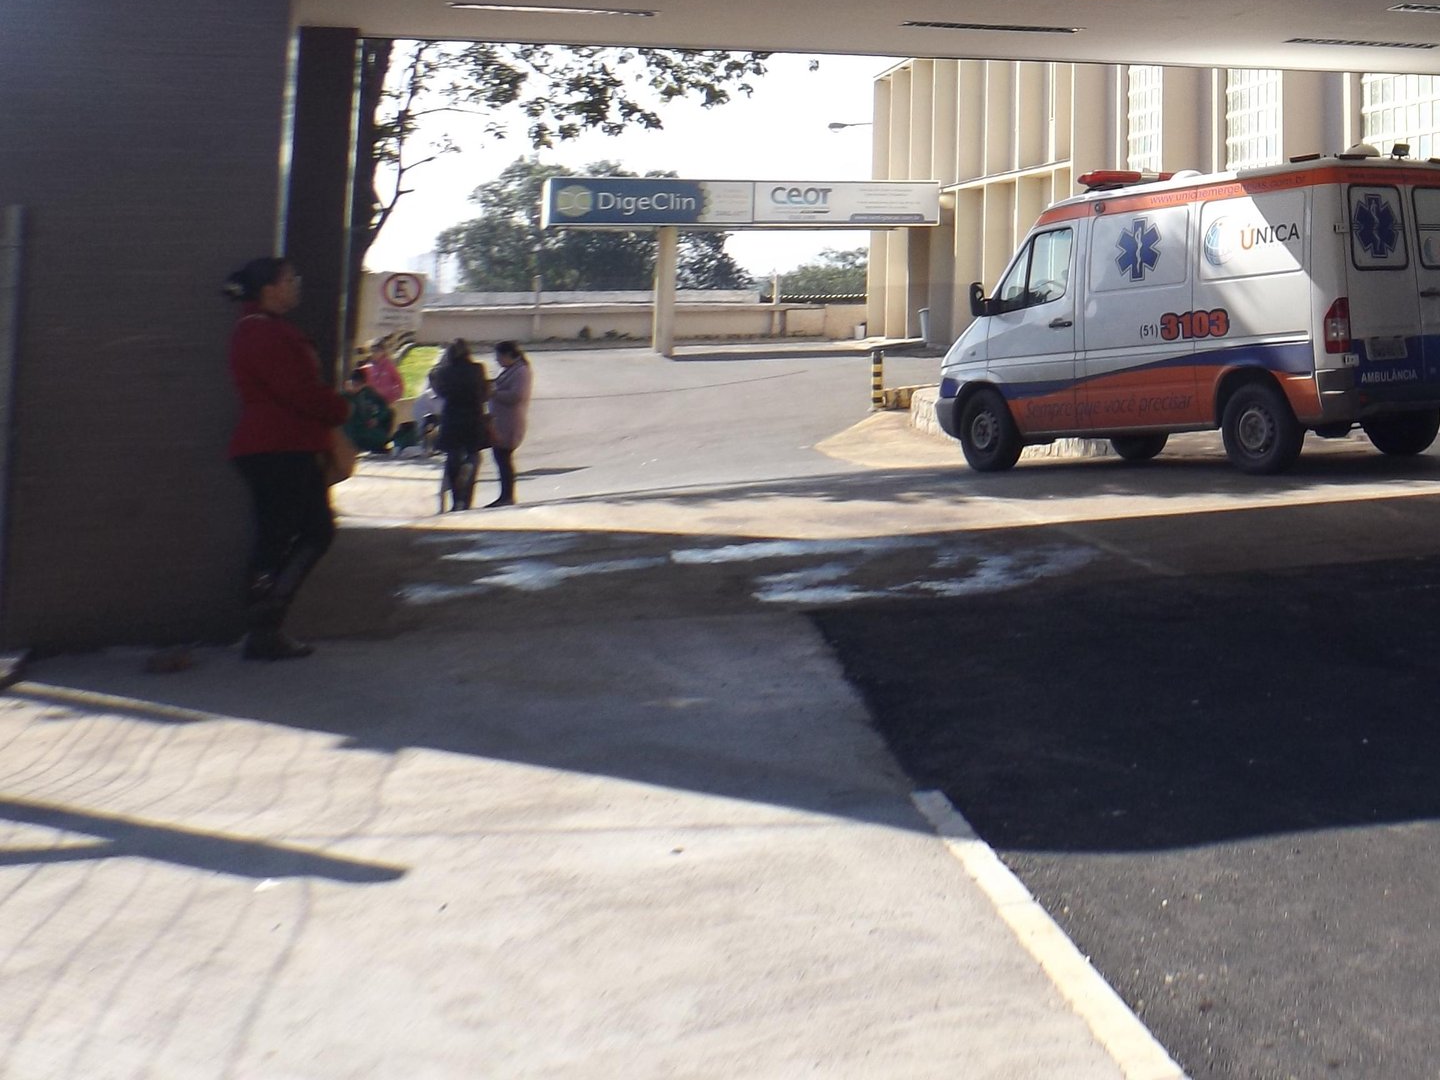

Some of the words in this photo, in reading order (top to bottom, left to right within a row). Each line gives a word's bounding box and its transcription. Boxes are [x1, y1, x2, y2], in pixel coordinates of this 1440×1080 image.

[597, 191, 696, 216] DigeClin
[1240, 222, 1301, 251] ÚNICA
[1139, 323, 1159, 339] (51)
[1160, 307, 1231, 341] 3103
[1360, 367, 1419, 384] AMBULÂNCIA
[1138, 392, 1193, 416] precisar
